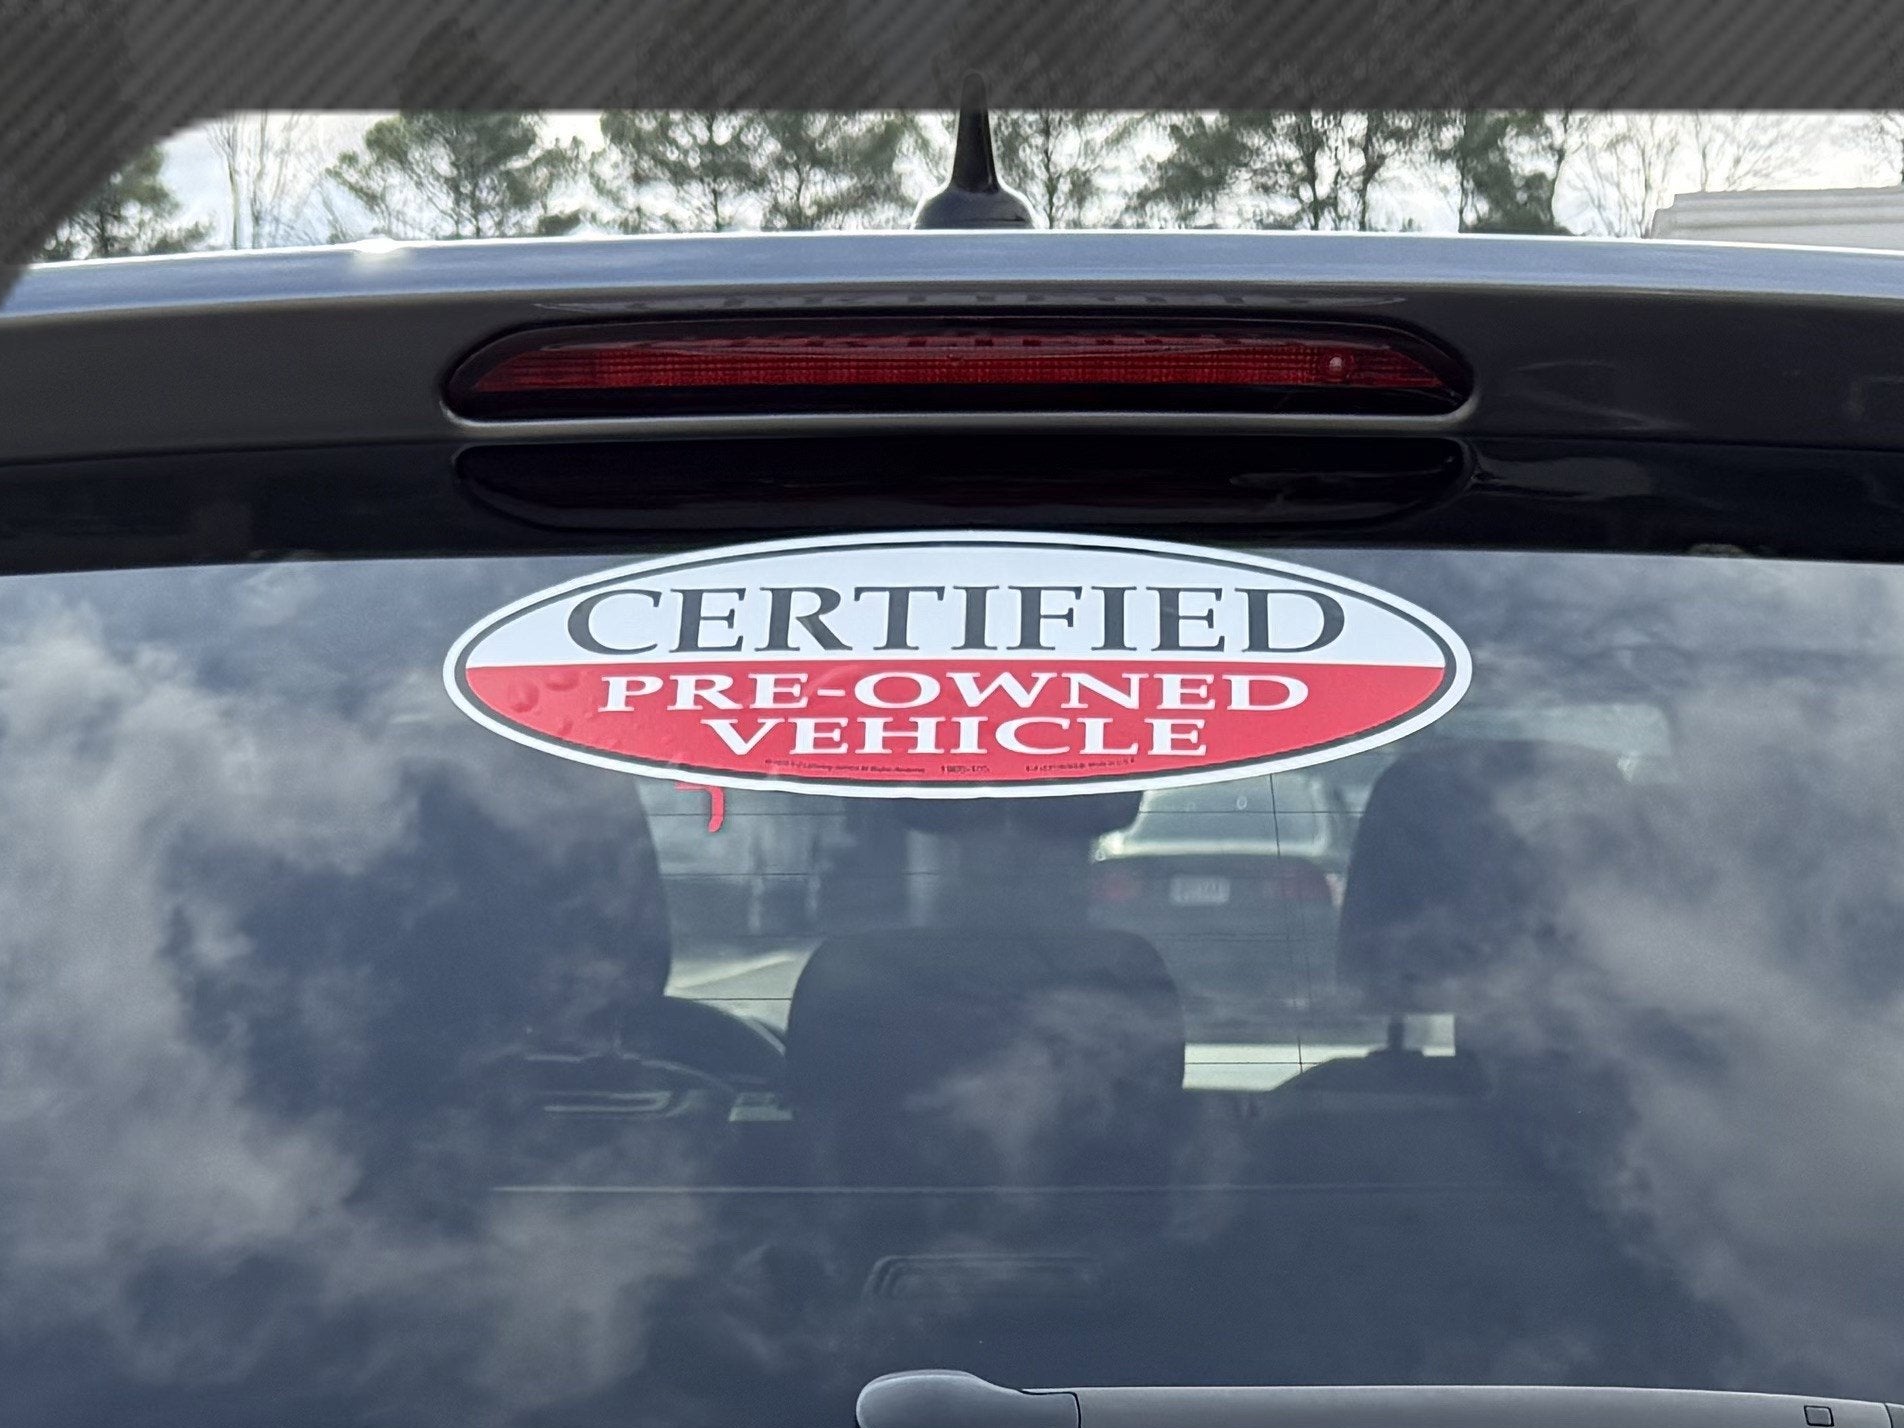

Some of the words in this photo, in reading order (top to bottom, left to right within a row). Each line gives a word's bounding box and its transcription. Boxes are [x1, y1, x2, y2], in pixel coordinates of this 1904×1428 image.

[566, 585, 1348, 656] CERTIFIED
[597, 671, 1310, 713] PRE-OWNED
[700, 715, 1209, 757] VEHICLE
